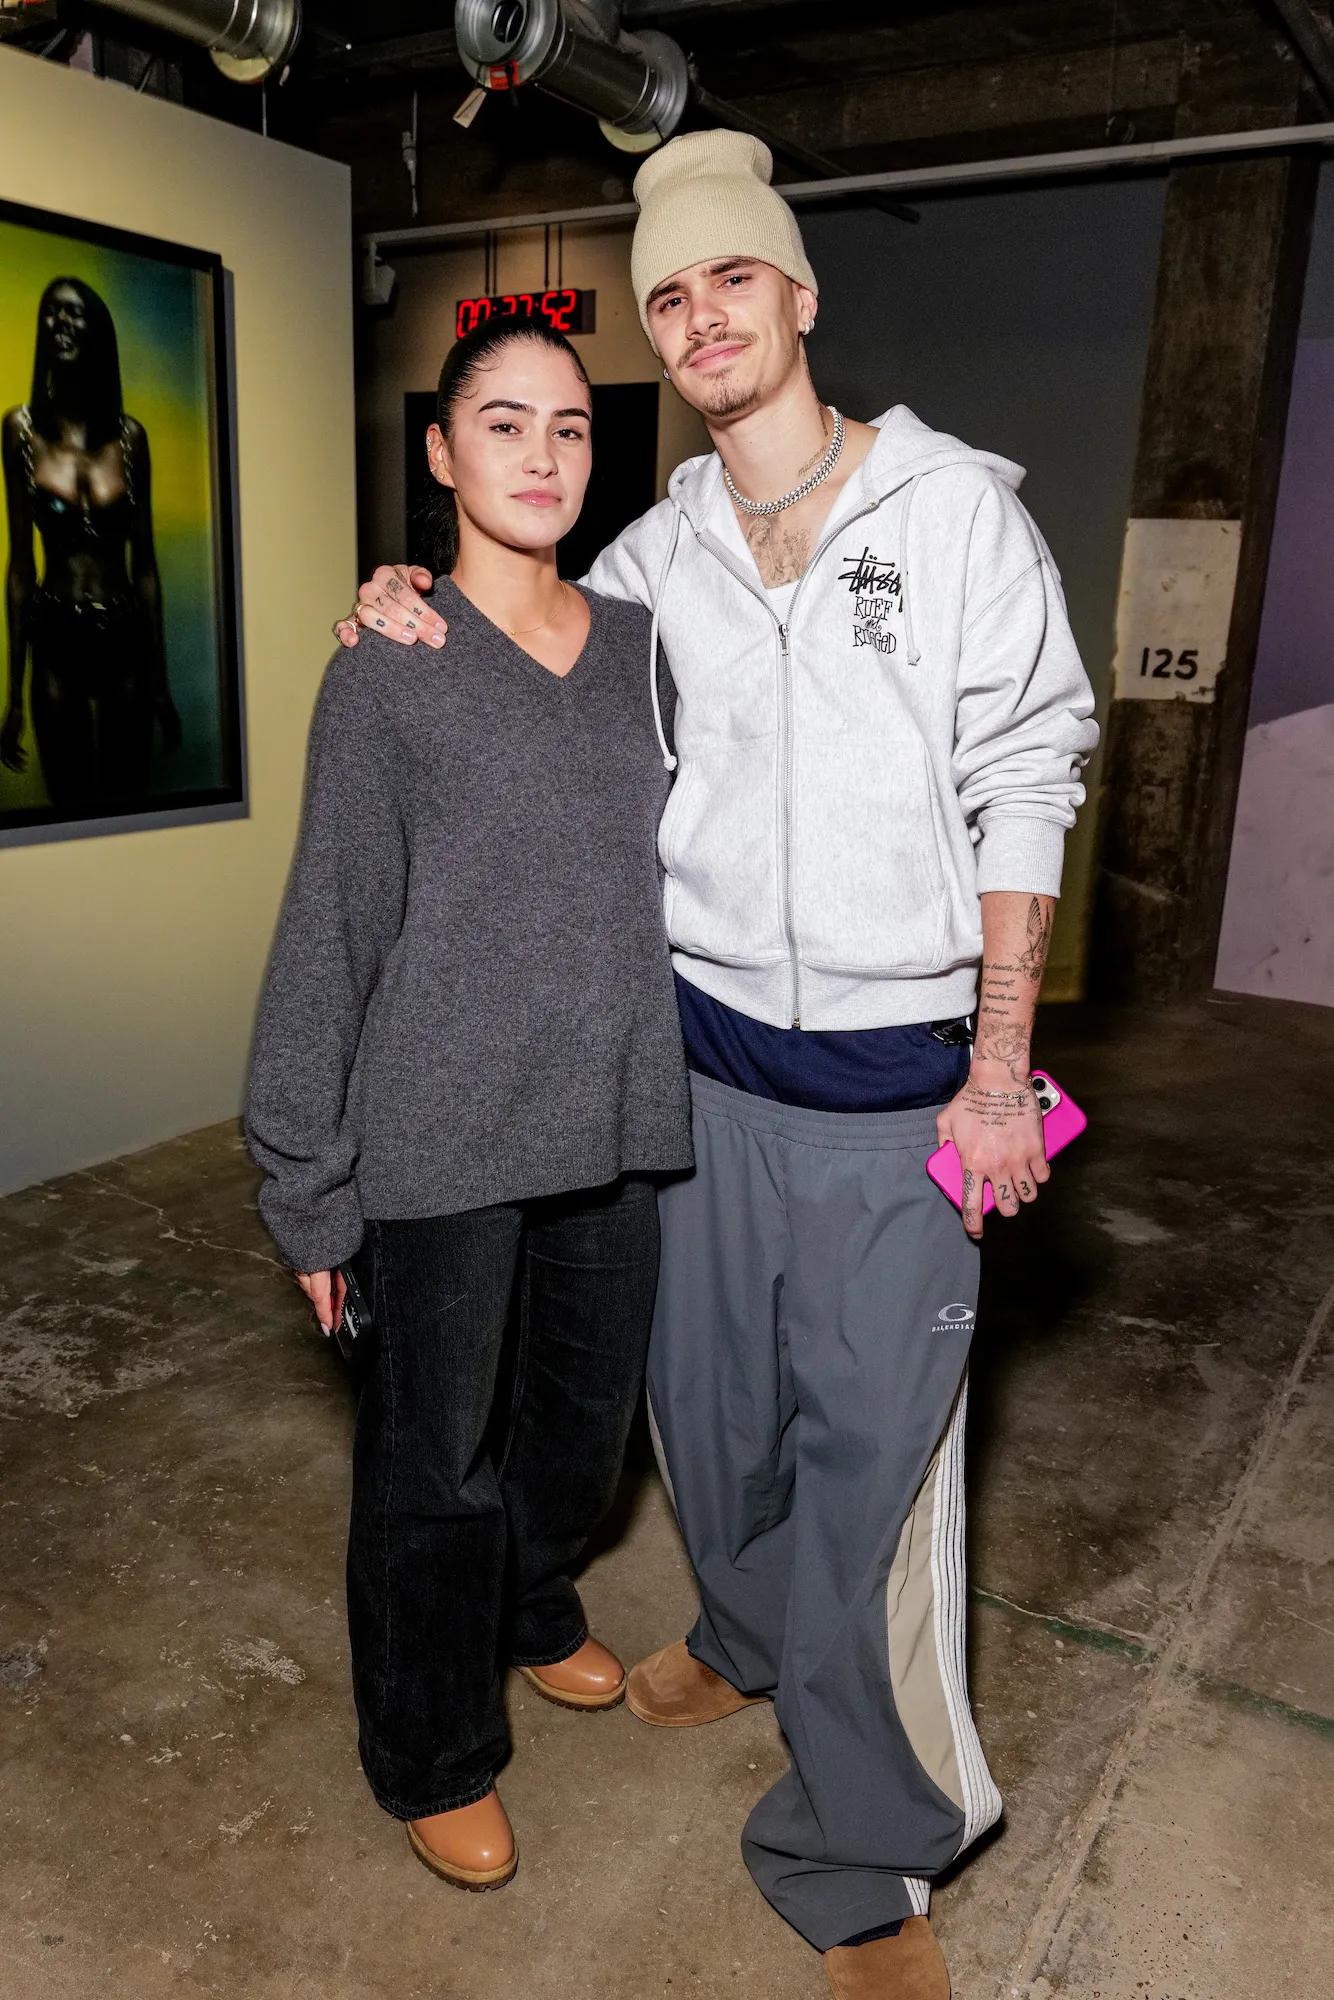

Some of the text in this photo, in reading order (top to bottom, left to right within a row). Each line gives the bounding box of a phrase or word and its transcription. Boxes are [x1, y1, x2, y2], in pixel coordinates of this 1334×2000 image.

[1140, 647, 1199, 680] 125
[998, 1181, 1031, 1201] 2 3
[931, 1323, 975, 1332] BALENCIAG
